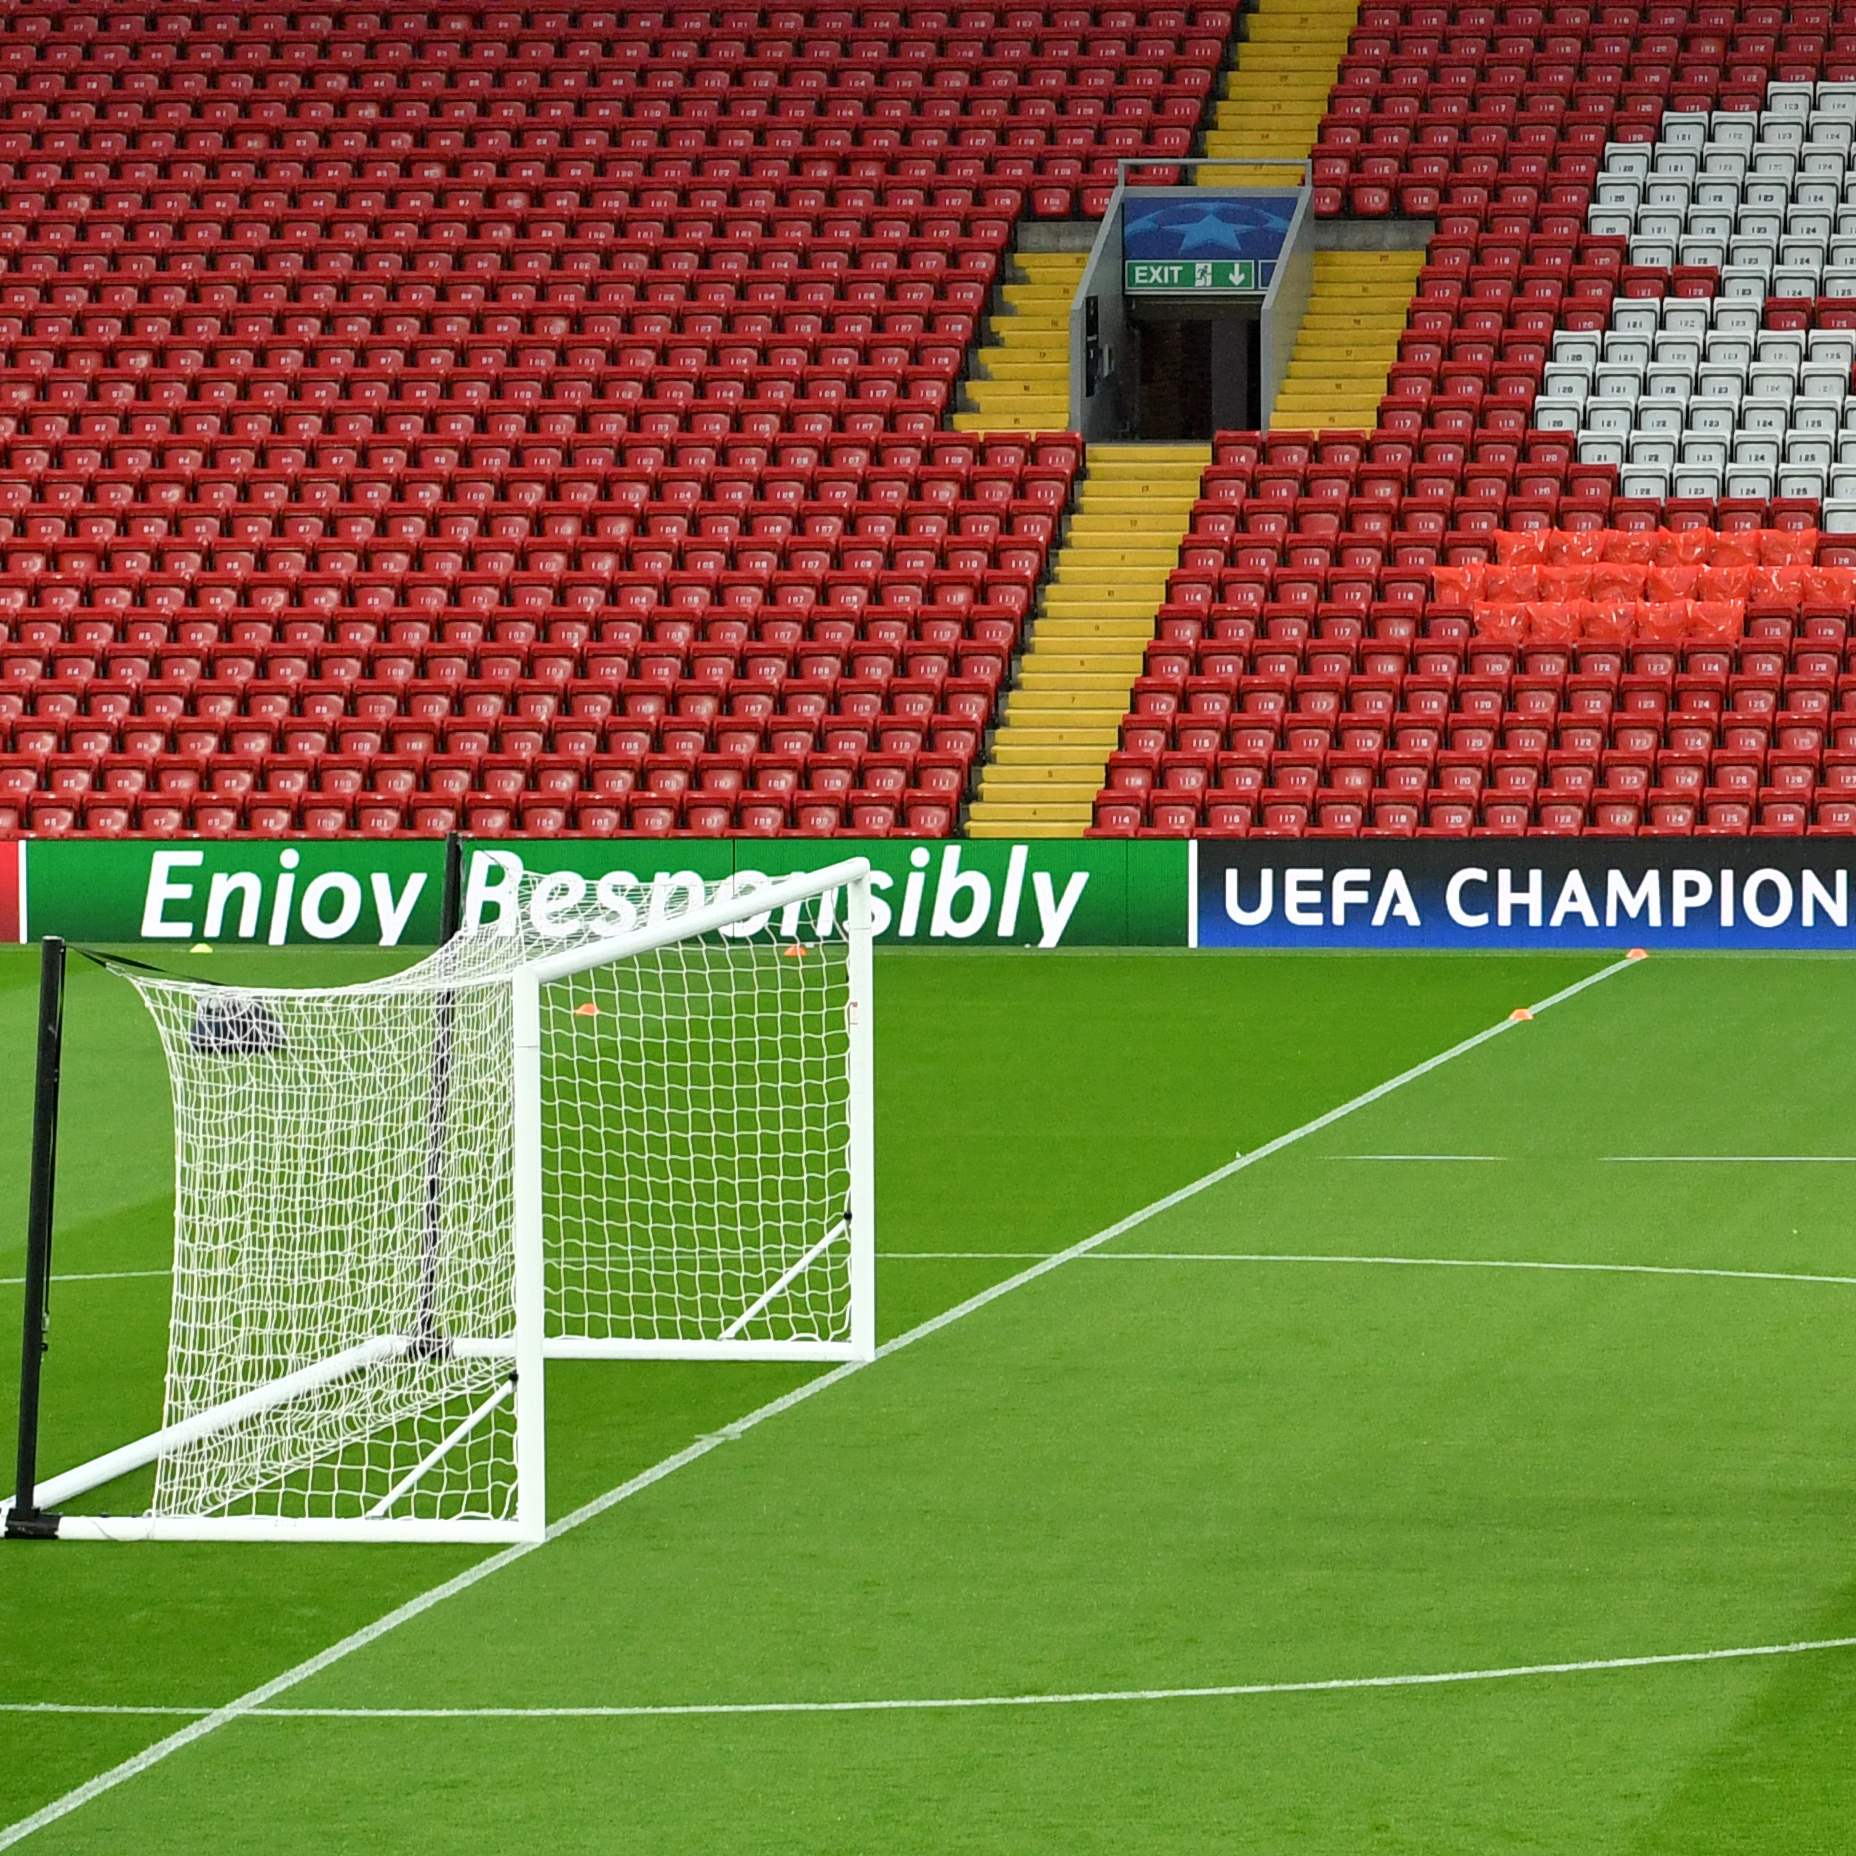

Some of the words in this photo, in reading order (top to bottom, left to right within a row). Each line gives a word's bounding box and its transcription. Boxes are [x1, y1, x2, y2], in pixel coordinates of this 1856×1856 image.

[1134, 266, 1183, 284] EXIT
[1278, 814, 1296, 823] 117
[142, 849, 428, 948] Enjoy
[1225, 868, 1421, 926] UEFA
